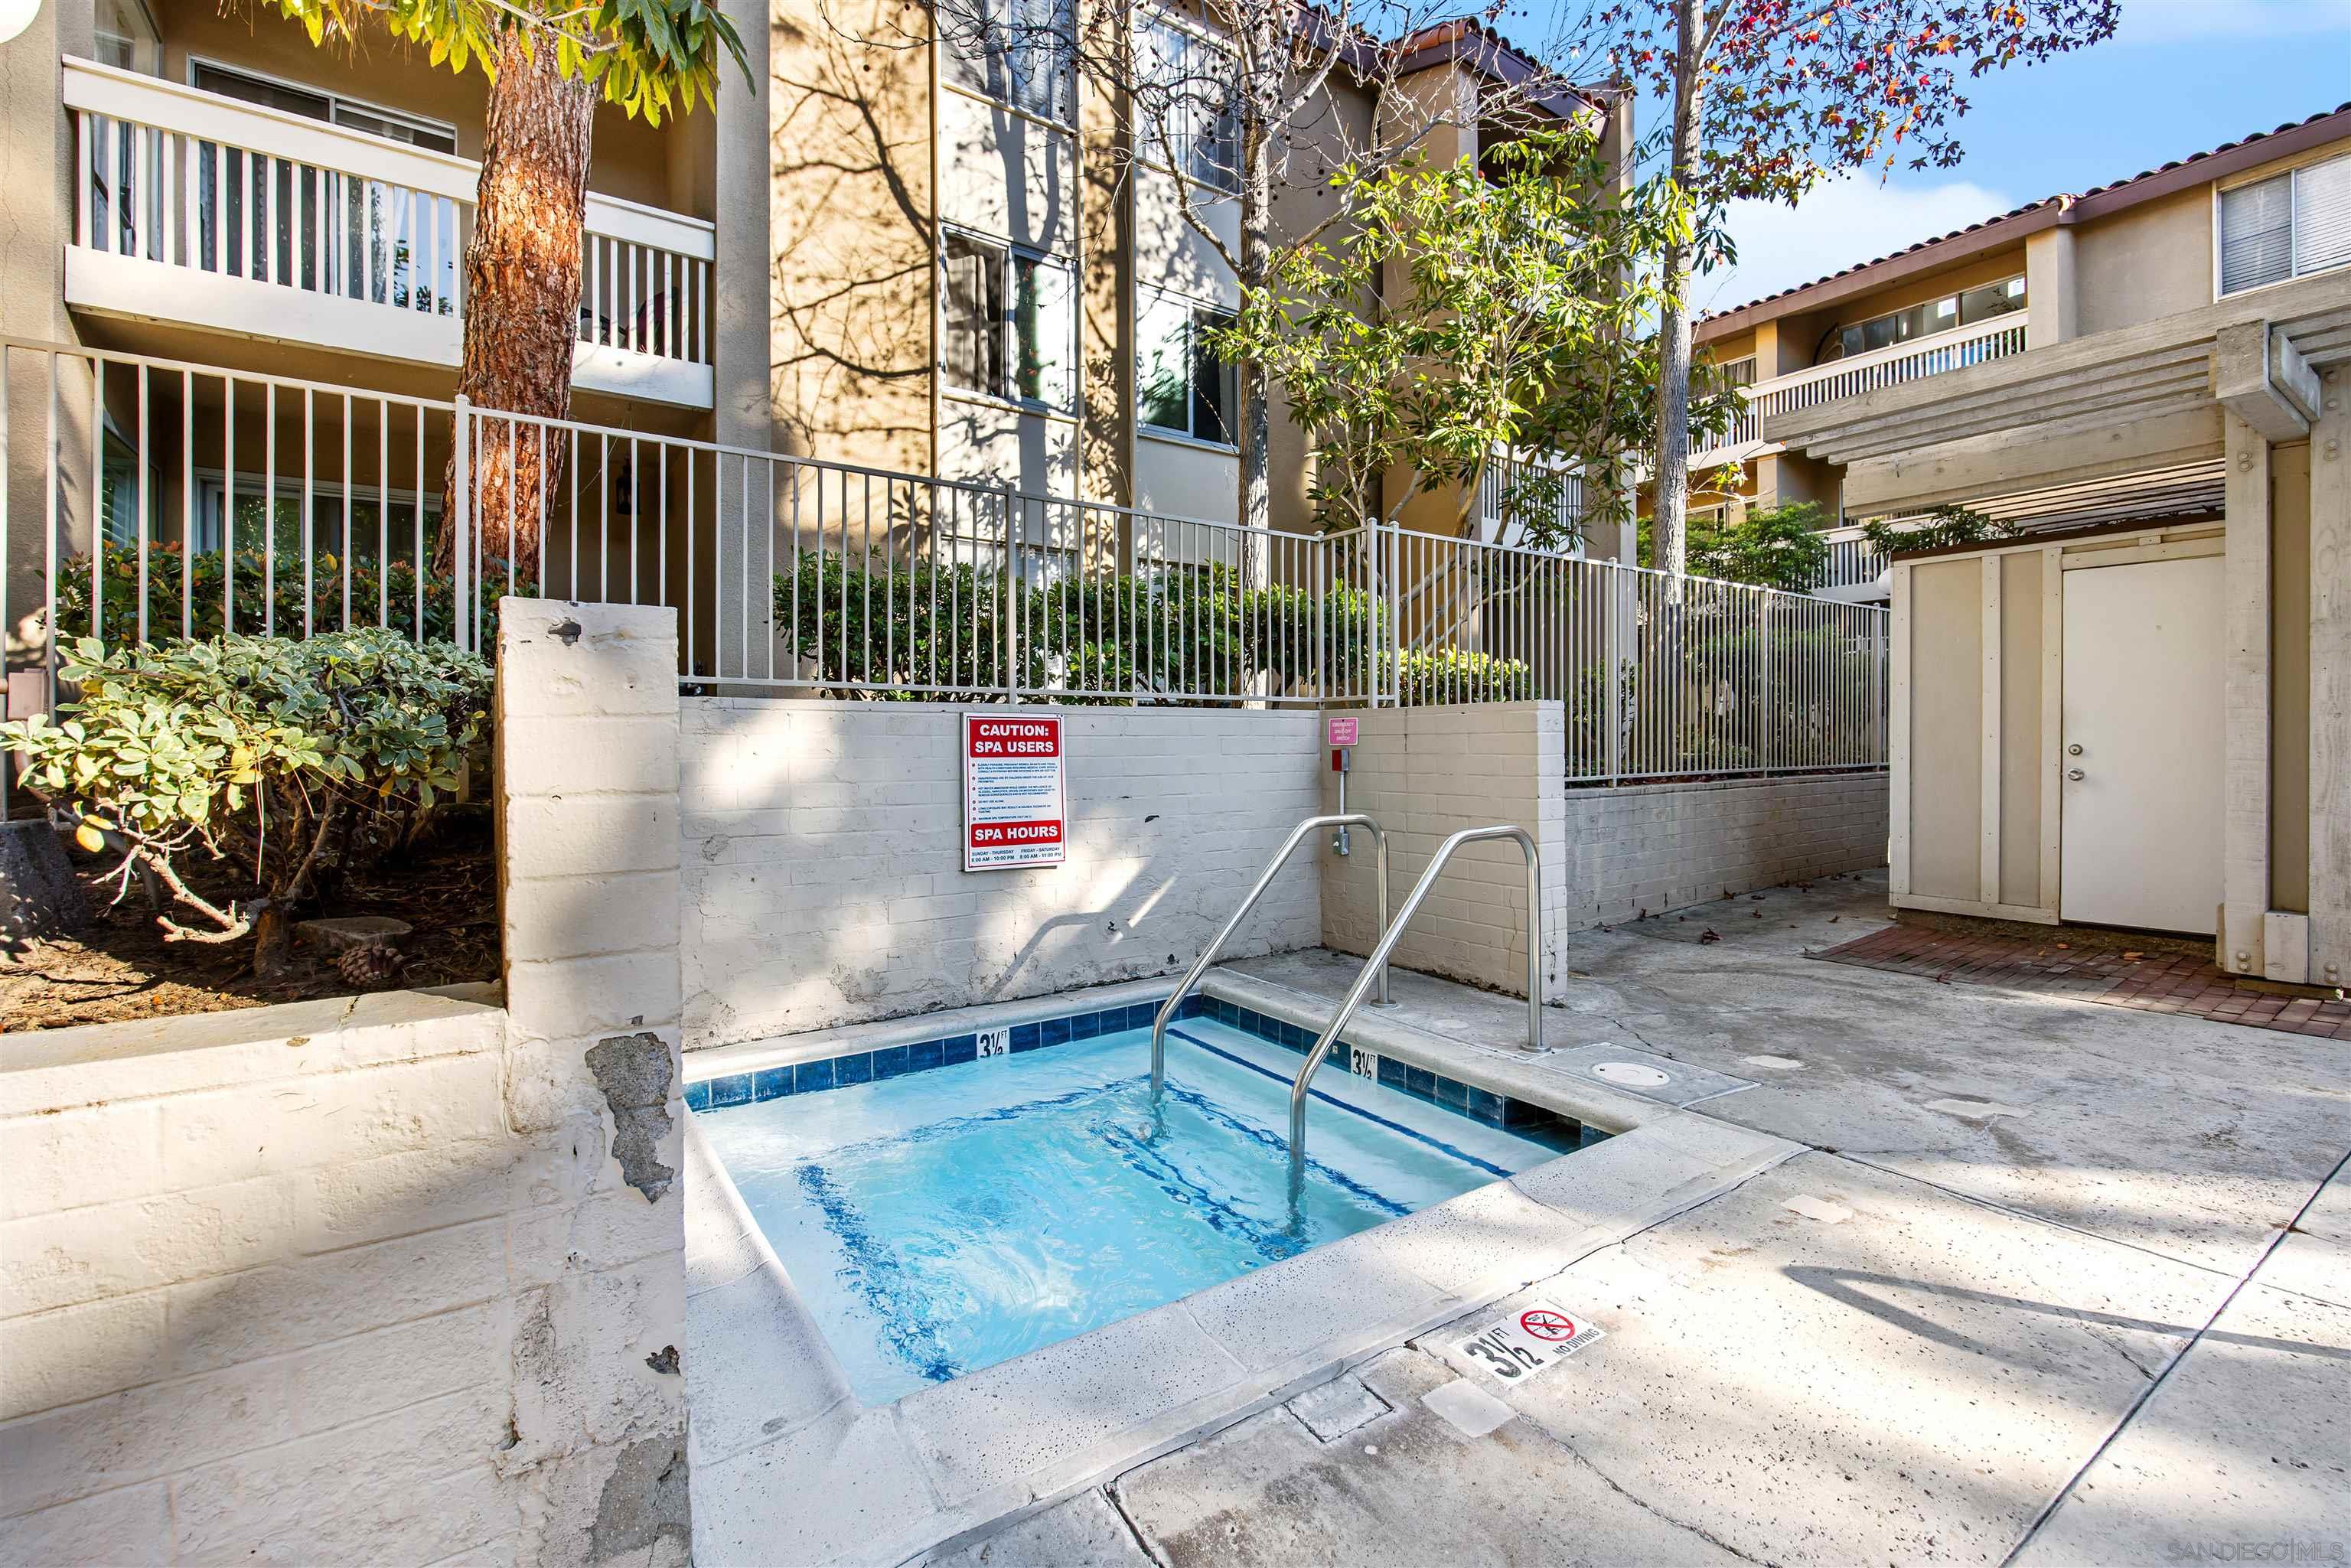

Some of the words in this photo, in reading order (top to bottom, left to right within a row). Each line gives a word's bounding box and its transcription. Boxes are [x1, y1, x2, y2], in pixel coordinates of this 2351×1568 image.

[980, 724, 1049, 736] CAUTION:
[975, 741, 1003, 753] SPA
[1007, 741, 1055, 753] USERS
[975, 828, 1003, 841] SPA
[1007, 825, 1058, 839] HOURS
[1492, 1327, 1511, 1339] FT
[1552, 1345, 1570, 1357] NO
[1568, 1328, 1600, 1348] DIVING
